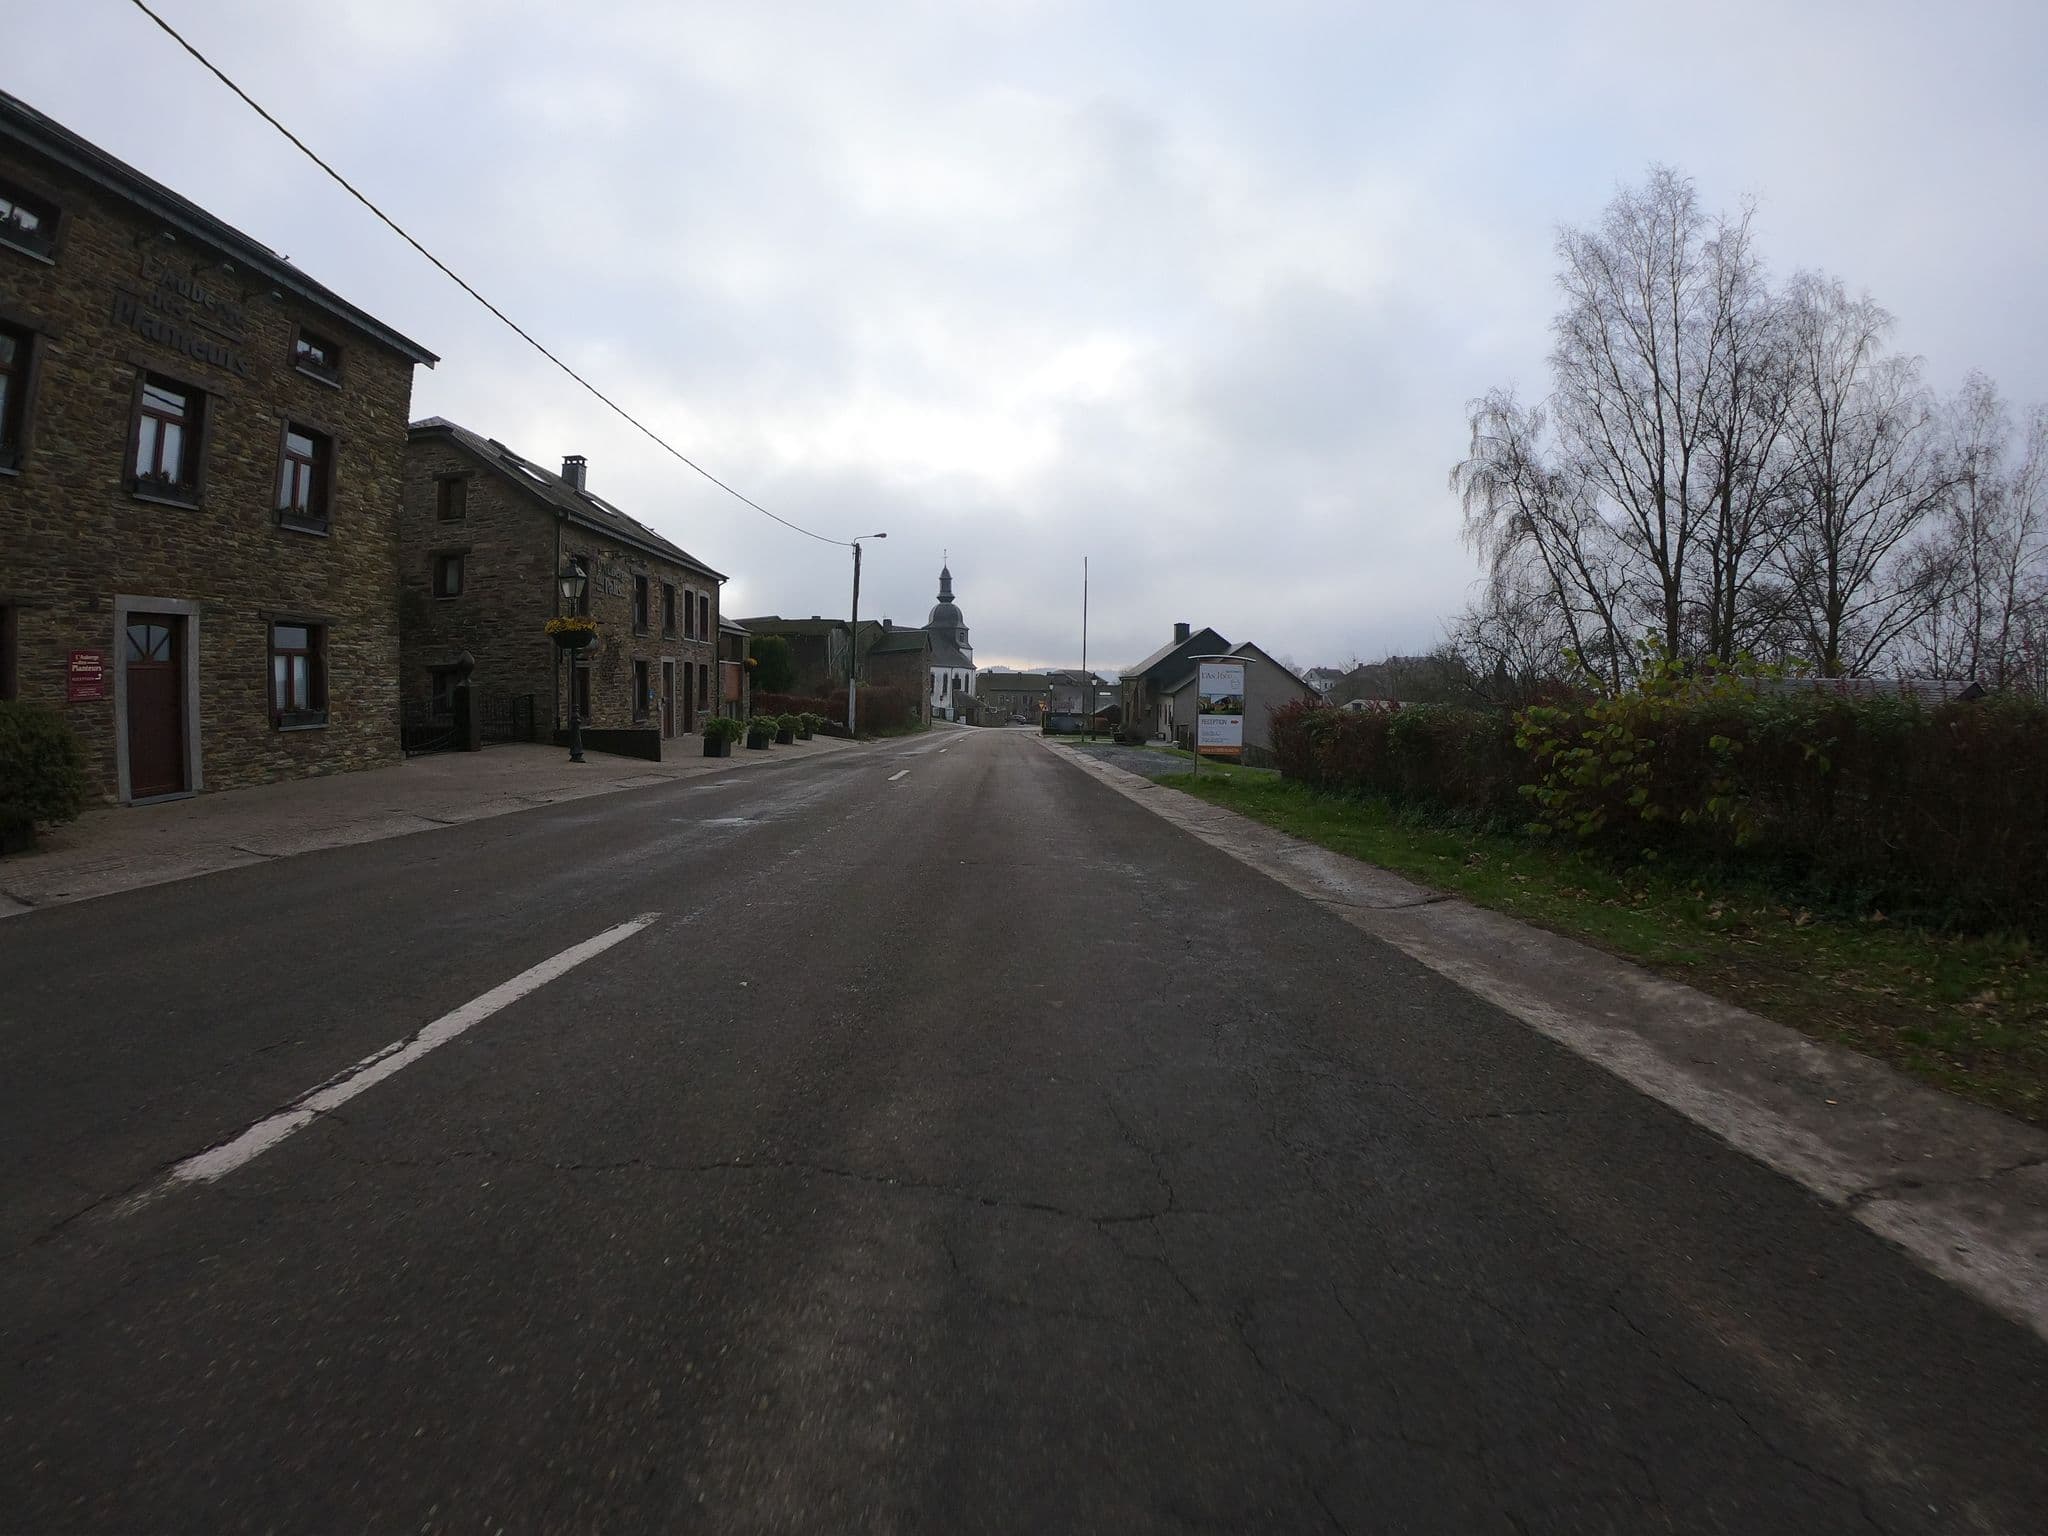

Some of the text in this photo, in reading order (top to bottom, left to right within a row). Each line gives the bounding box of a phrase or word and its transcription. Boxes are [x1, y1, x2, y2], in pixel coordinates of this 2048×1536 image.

[140, 255, 246, 332] L'Aube
[112, 291, 250, 377] Planteurs
[72, 664, 102, 672] Planteurs
